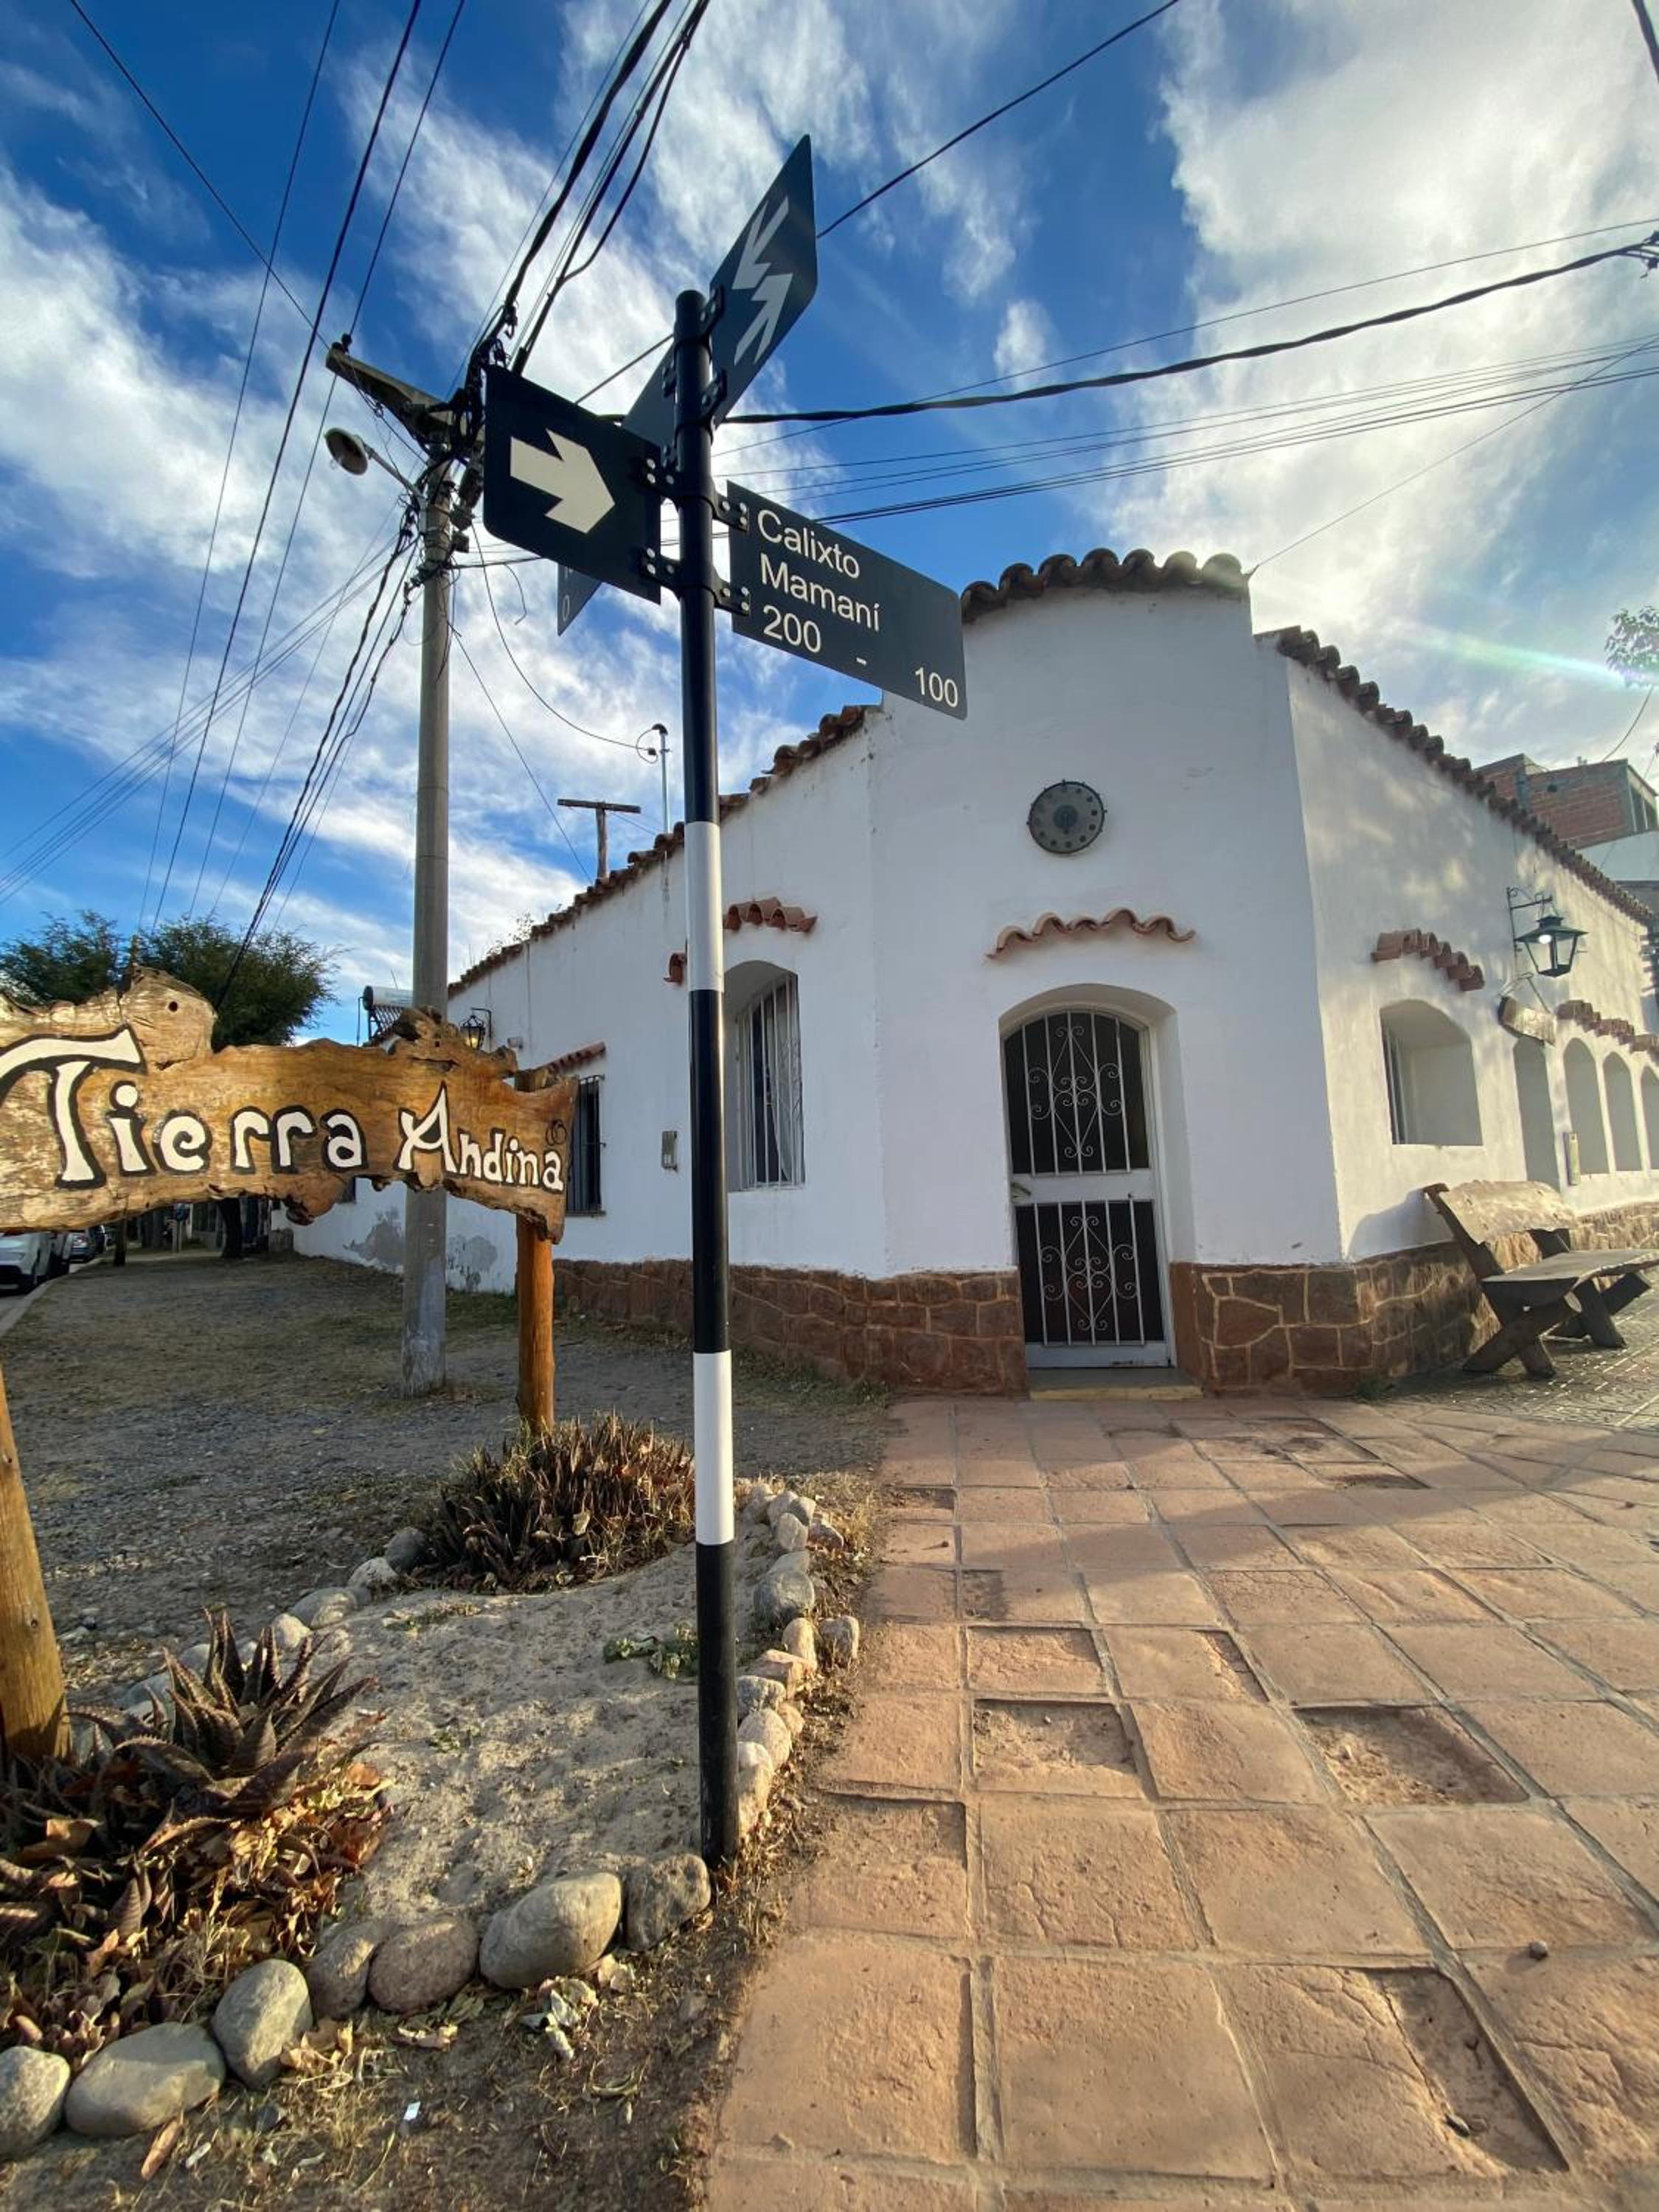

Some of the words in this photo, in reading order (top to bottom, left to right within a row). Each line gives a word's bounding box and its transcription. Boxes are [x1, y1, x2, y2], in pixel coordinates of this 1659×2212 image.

[757, 509, 860, 579] Calixto
[760, 552, 880, 632] Mamaní
[763, 605, 821, 653] 200
[914, 667, 959, 708] 100
[0, 1027, 364, 1183] Tierra
[397, 1084, 565, 1192] Andina
